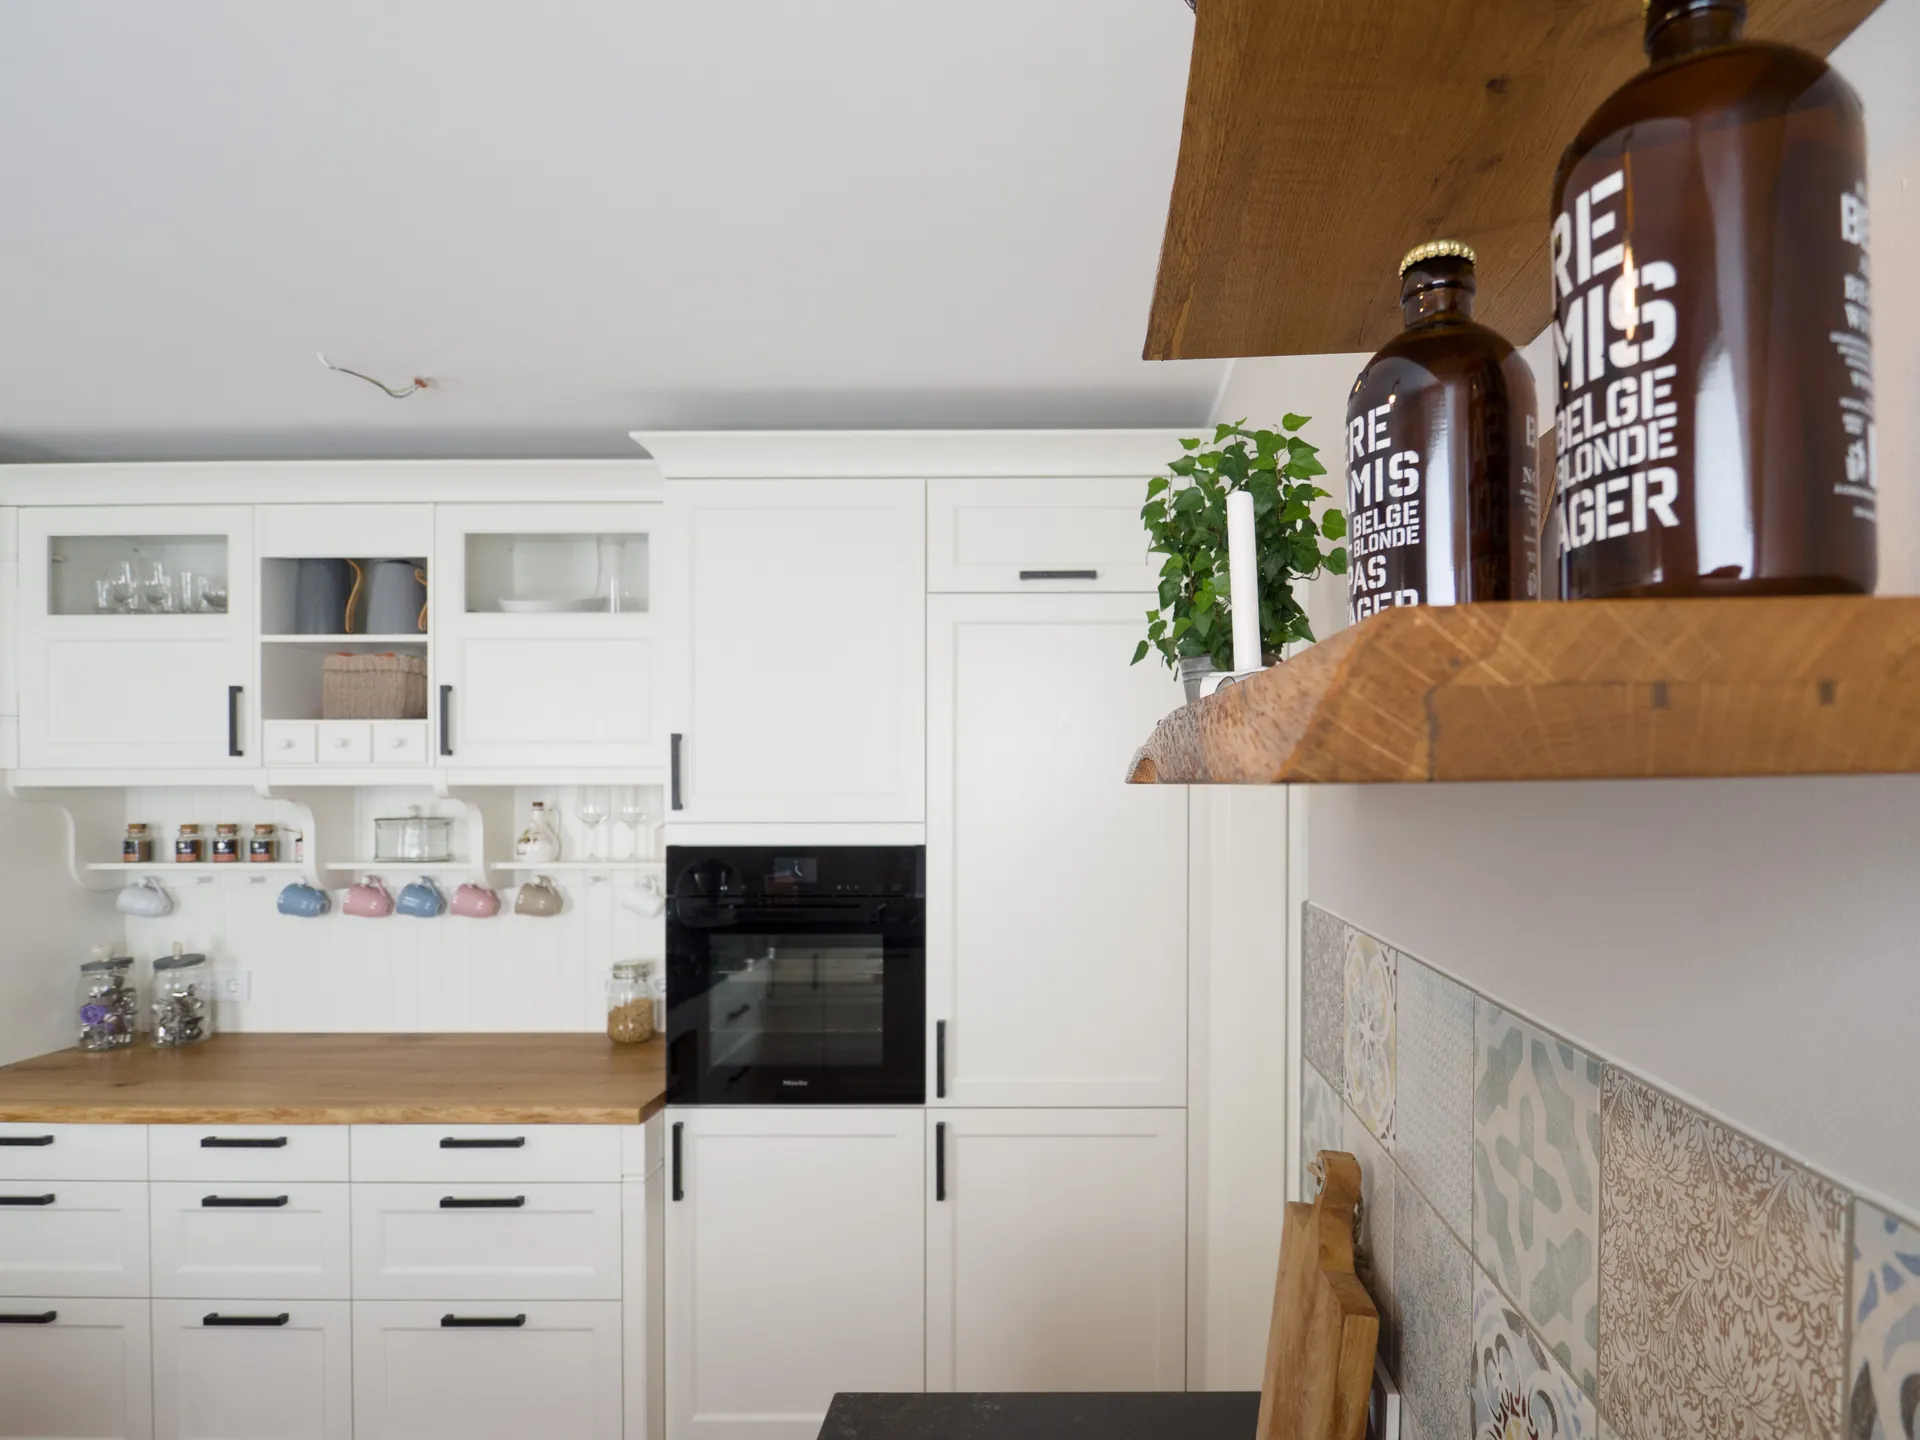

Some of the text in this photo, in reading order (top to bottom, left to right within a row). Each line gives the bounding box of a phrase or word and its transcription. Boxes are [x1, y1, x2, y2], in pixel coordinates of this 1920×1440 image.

[1347, 403, 1392, 464] RE
[1556, 364, 1678, 455] BELGE
[1348, 450, 1420, 514] MIS
[1557, 416, 1678, 495] BLONDE
[1353, 499, 1420, 539] BELGE
[1353, 524, 1420, 559] BLONDE
